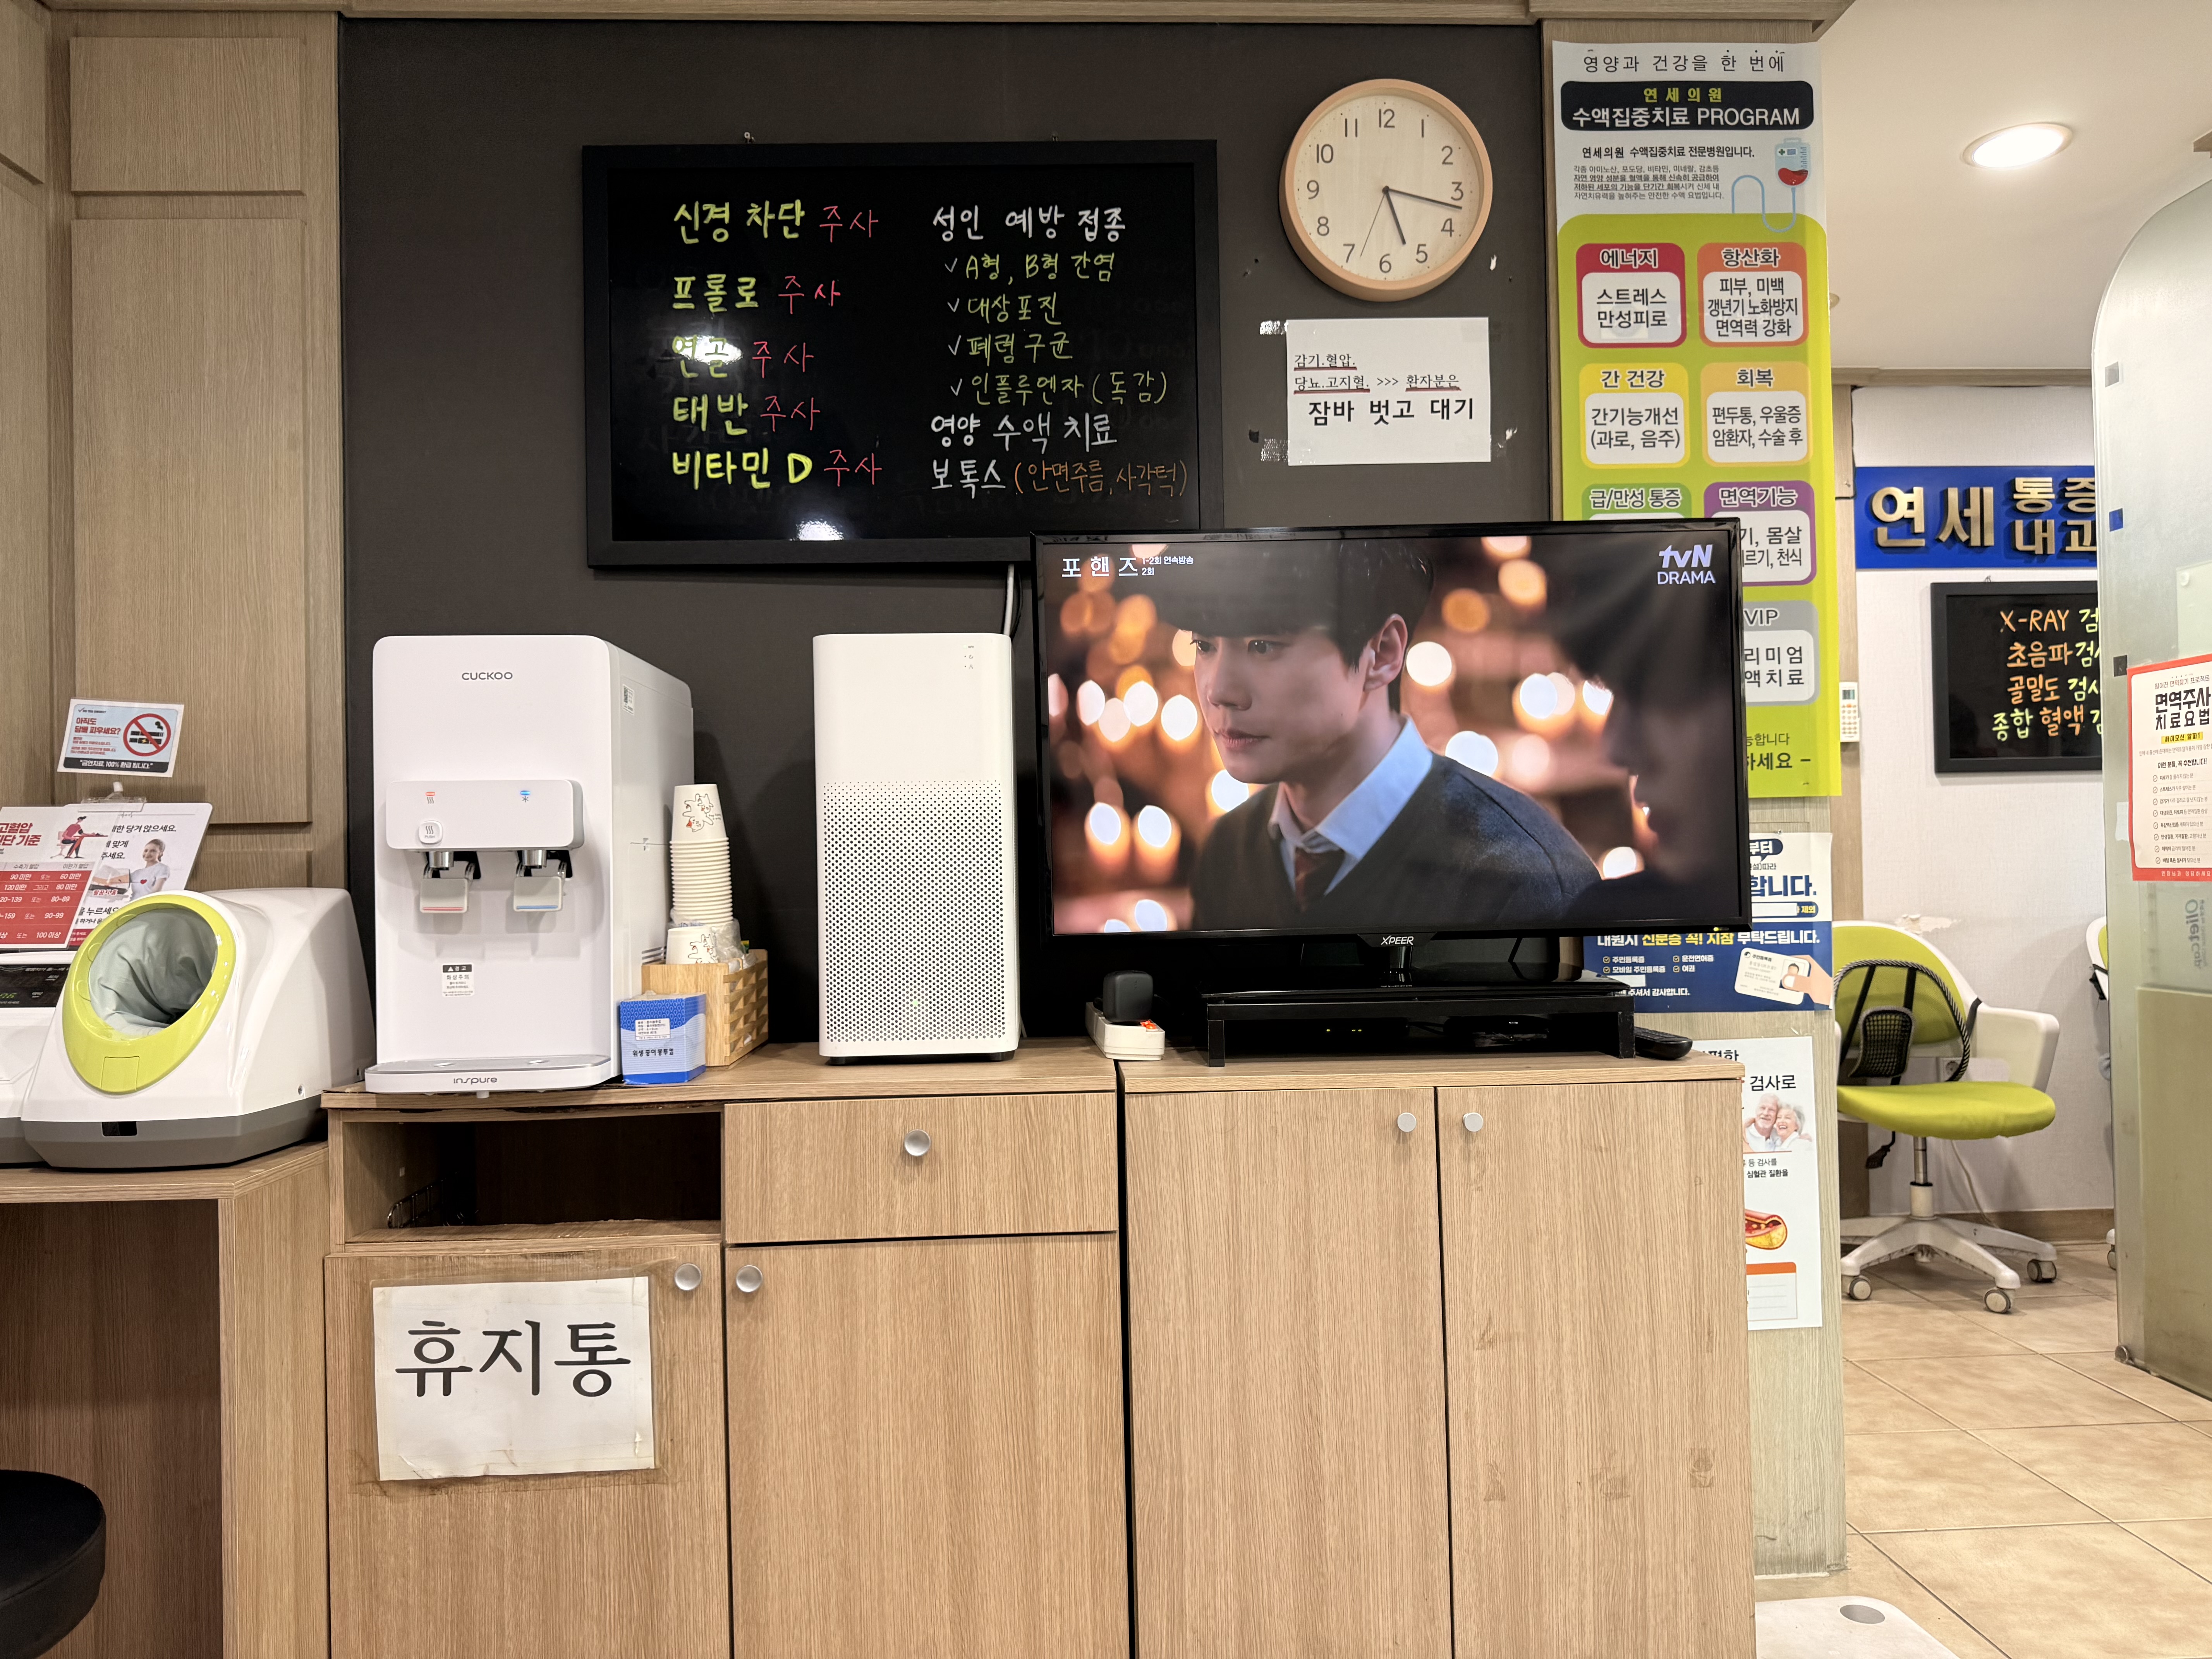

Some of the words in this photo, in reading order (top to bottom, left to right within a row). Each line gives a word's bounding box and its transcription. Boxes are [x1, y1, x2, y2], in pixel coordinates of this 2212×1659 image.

[1583, 56, 1639, 72] 영양과
[1652, 55, 1707, 72] 건강을
[1721, 55, 1736, 72] 한
[1750, 54, 1784, 72] 번에
[1378, 109, 1395, 128] 12
[1572, 108, 1690, 127] 수액집중치료
[1697, 108, 1799, 125] PROGRAM
[1344, 118, 1358, 138] 11
[1420, 118, 1425, 138] 1
[1316, 144, 1334, 163] 10
[1441, 146, 1453, 165] 2
[1582, 147, 1624, 159] 연세의원
[1630, 147, 1686, 157] 수액집중치료
[1688, 146, 1755, 157] 전문병원입니다.
[1307, 180, 1320, 199] 9
[1451, 181, 1463, 201] 3
[674, 200, 730, 244] 신경
[746, 199, 805, 239] 차단
[819, 206, 879, 242] 주사
[933, 205, 984, 242] 성인
[1005, 205, 1065, 239] 예방
[1078, 206, 1125, 242] 접종
[1317, 217, 1330, 235] 8
[1441, 218, 1454, 238] 4
[1343, 244, 1355, 263] 7
[1415, 244, 1428, 263] 5
[1601, 250, 1657, 268] 에너지
[1723, 249, 1779, 266] 항산화
[1025, 252, 1058, 280] B형
[1071, 251, 1115, 282] 간염
[1379, 254, 1392, 273] 6
[672, 273, 759, 313] 프롤로
[778, 276, 841, 314] 주사
[1719, 278, 1751, 297] 피부,
[1757, 278, 1784, 294] 미백
[1597, 289, 1667, 306] 스트레스
[1708, 299, 1745, 316] 갱년기
[1748, 298, 1798, 316] 노화방지
[1597, 311, 1668, 328] 만성피로
[1716, 320, 1757, 337] 면역력
[1762, 319, 1791, 337] 강화
[672, 335, 729, 378] 연골
[752, 341, 814, 378] 주사
[1406, 374, 1460, 388] 환자분은
[1601, 371, 1620, 388] 간
[1627, 371, 1664, 388] 건강
[1737, 369, 1773, 386] 회복
[673, 393, 749, 436] 태반
[760, 395, 820, 432] 주사
[1308, 400, 1354, 426] 잠바
[1369, 399, 1415, 425] 벗고
[1430, 398, 1473, 420] 대기
[1592, 407, 1678, 426] 간기능개선
[1712, 407, 1756, 426] 편두통,
[1760, 406, 1802, 423] 우울증
[931, 413, 981, 447] 영양
[993, 411, 1051, 455] 수액
[1064, 412, 1117, 452] 치료
[1590, 429, 1635, 450] (과로,
[1640, 429, 1681, 449] 음주)
[1713, 429, 1755, 448] 암환자,
[1759, 428, 1786, 445] 수술
[1789, 428, 1803, 445] 후
[672, 447, 771, 490] 비타민
[787, 453, 813, 484] D
[823, 449, 882, 487] 주사
[931, 459, 1006, 499] 보톡스
[1590, 490, 1644, 508] 급/만성
[1649, 489, 1681, 508] 통증
[1720, 488, 1797, 507] 면역기능
[1872, 486, 1994, 547] 연세
[1766, 526, 1802, 544] 몸살
[1142, 556, 1161, 565] 1-2회
[1164, 556, 1194, 565] 연속방송
[1659, 544, 1713, 568] tvN
[1777, 548, 1802, 566] 천식
[1142, 567, 1154, 576] 2회
[1657, 570, 1716, 585] DRAMA
[1744, 610, 1778, 625] VIP
[2000, 610, 2069, 632] X-RAY
[2007, 641, 2073, 668] 초음파
[2075, 641, 2100, 667] 검
[462, 672, 513, 680] CUCKOO
[2008, 674, 2060, 704] 골밀도
[2155, 687, 2211, 713] 면역주사
[1992, 708, 2033, 741] 종합
[2039, 704, 2083, 737] 혈액
[2155, 708, 2210, 730] 치료요법
[89, 726, 121, 735] 피우세요?
[126, 825, 142, 833] 당겨
[143, 824, 177, 833] 앉으세요.
[16, 835, 41, 846] 기준
[1381, 935, 1413, 945] XPEER
[1652, 988, 1690, 996] 감사합니다.
[1750, 1075, 1796, 1092] 검사로
[1757, 1158, 1777, 1166] 검사를
[1747, 1170, 1766, 1178] 심혈관
[395, 1319, 631, 1397] 휴지통
